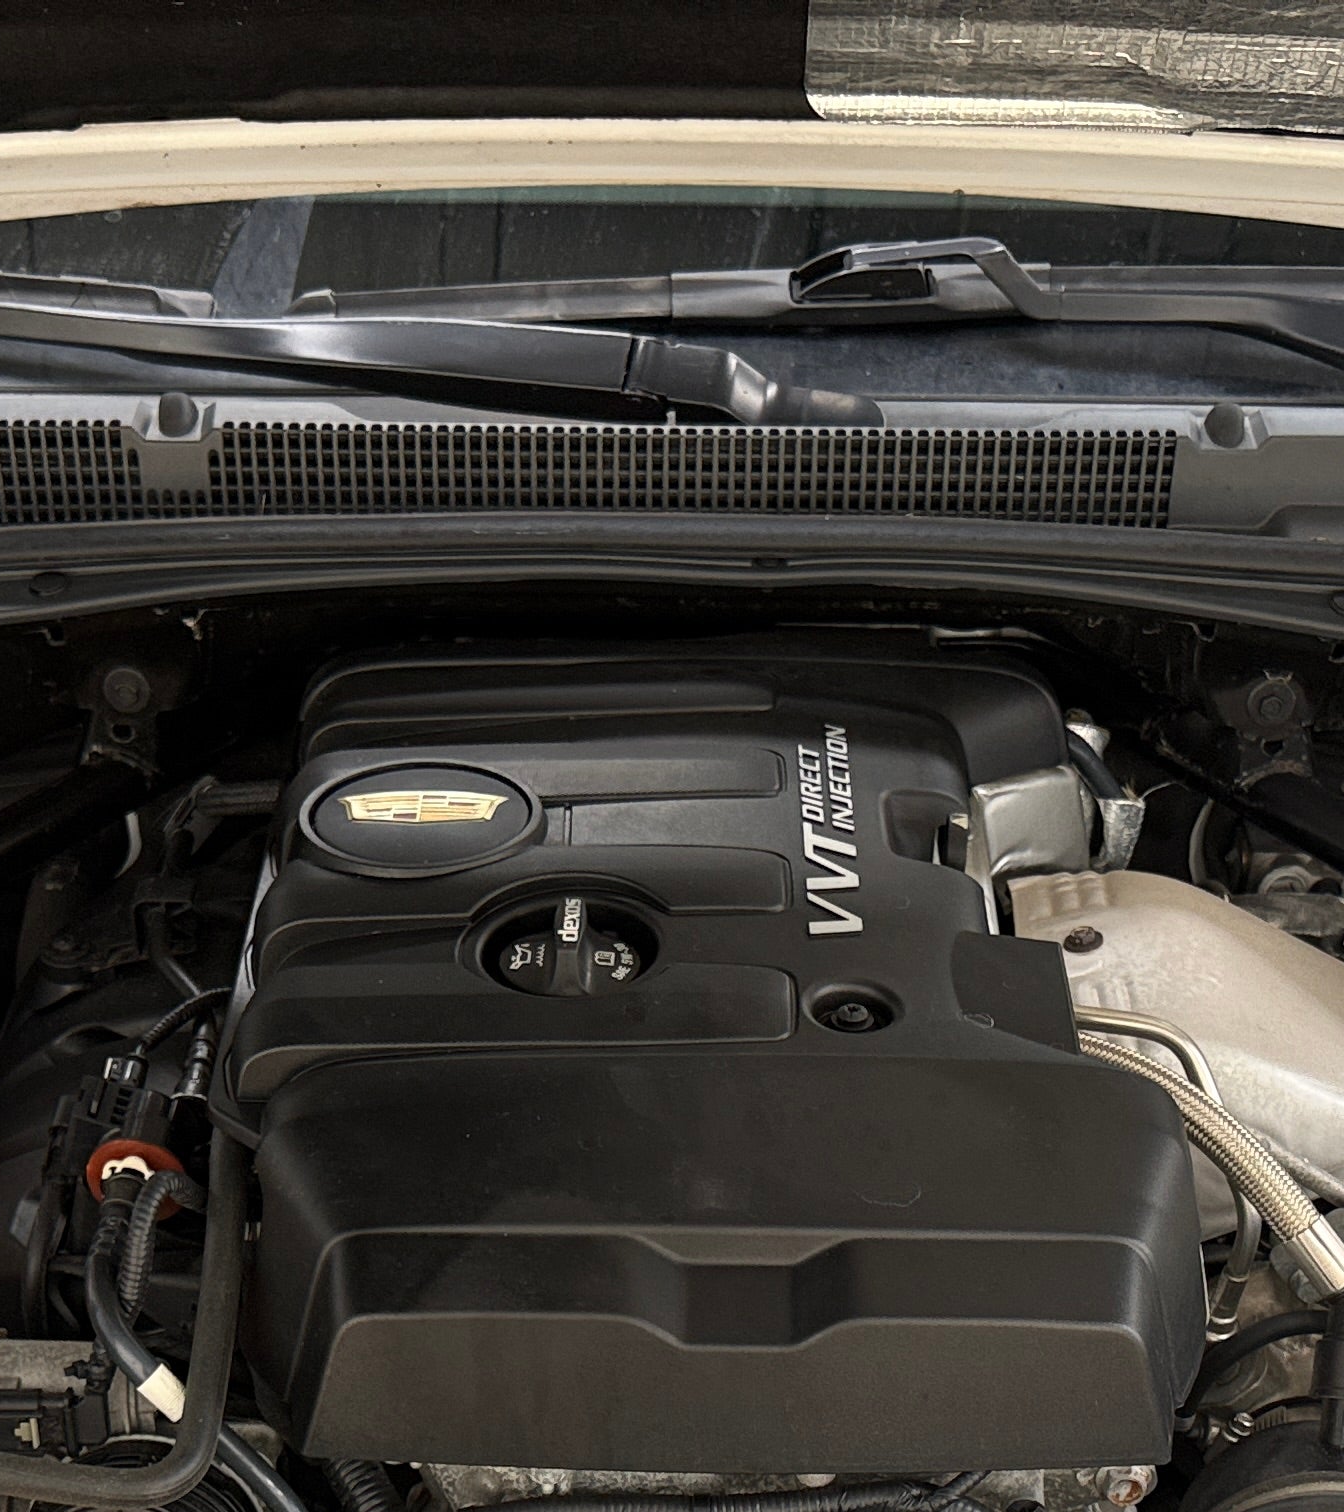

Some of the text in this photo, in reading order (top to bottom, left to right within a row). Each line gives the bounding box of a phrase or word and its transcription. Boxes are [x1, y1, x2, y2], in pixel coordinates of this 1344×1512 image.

[798, 744, 825, 823] DIRECT
[824, 724, 856, 832] INJECTION
[557, 897, 582, 942] dexos
[802, 821, 864, 935] VVT
